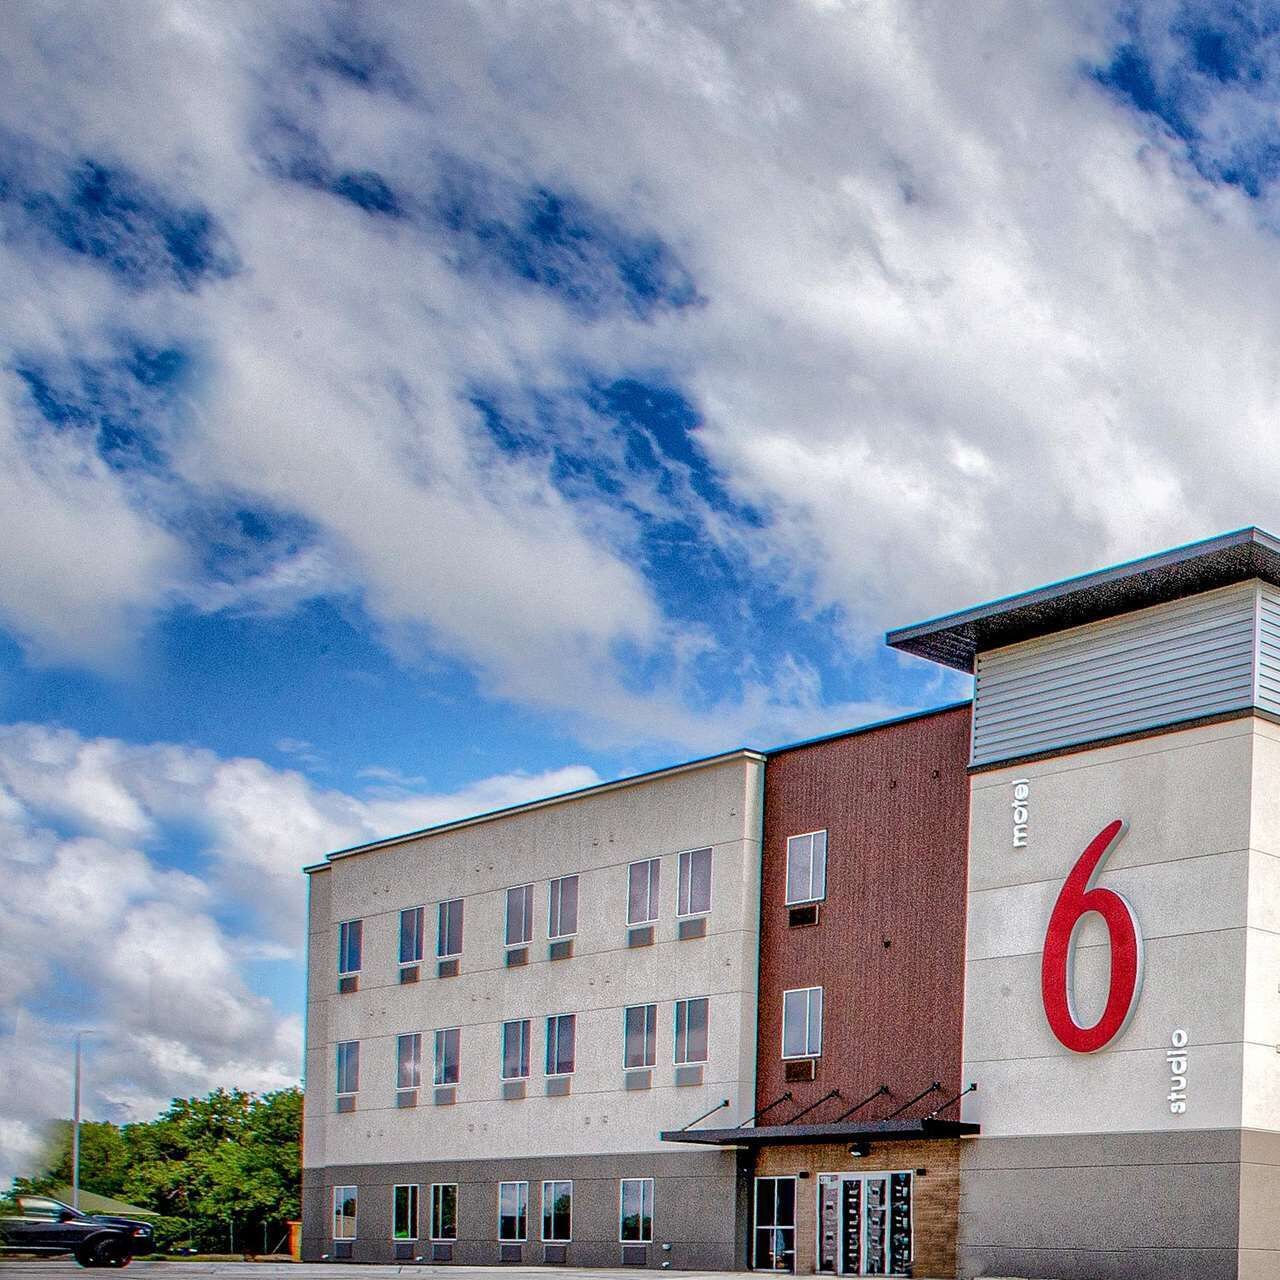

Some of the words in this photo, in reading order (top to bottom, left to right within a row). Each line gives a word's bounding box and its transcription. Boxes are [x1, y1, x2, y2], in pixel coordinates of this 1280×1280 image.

[1011, 778, 1030, 848] motel
[1041, 818, 1142, 1054] 6
[1166, 1029, 1188, 1114] studio
